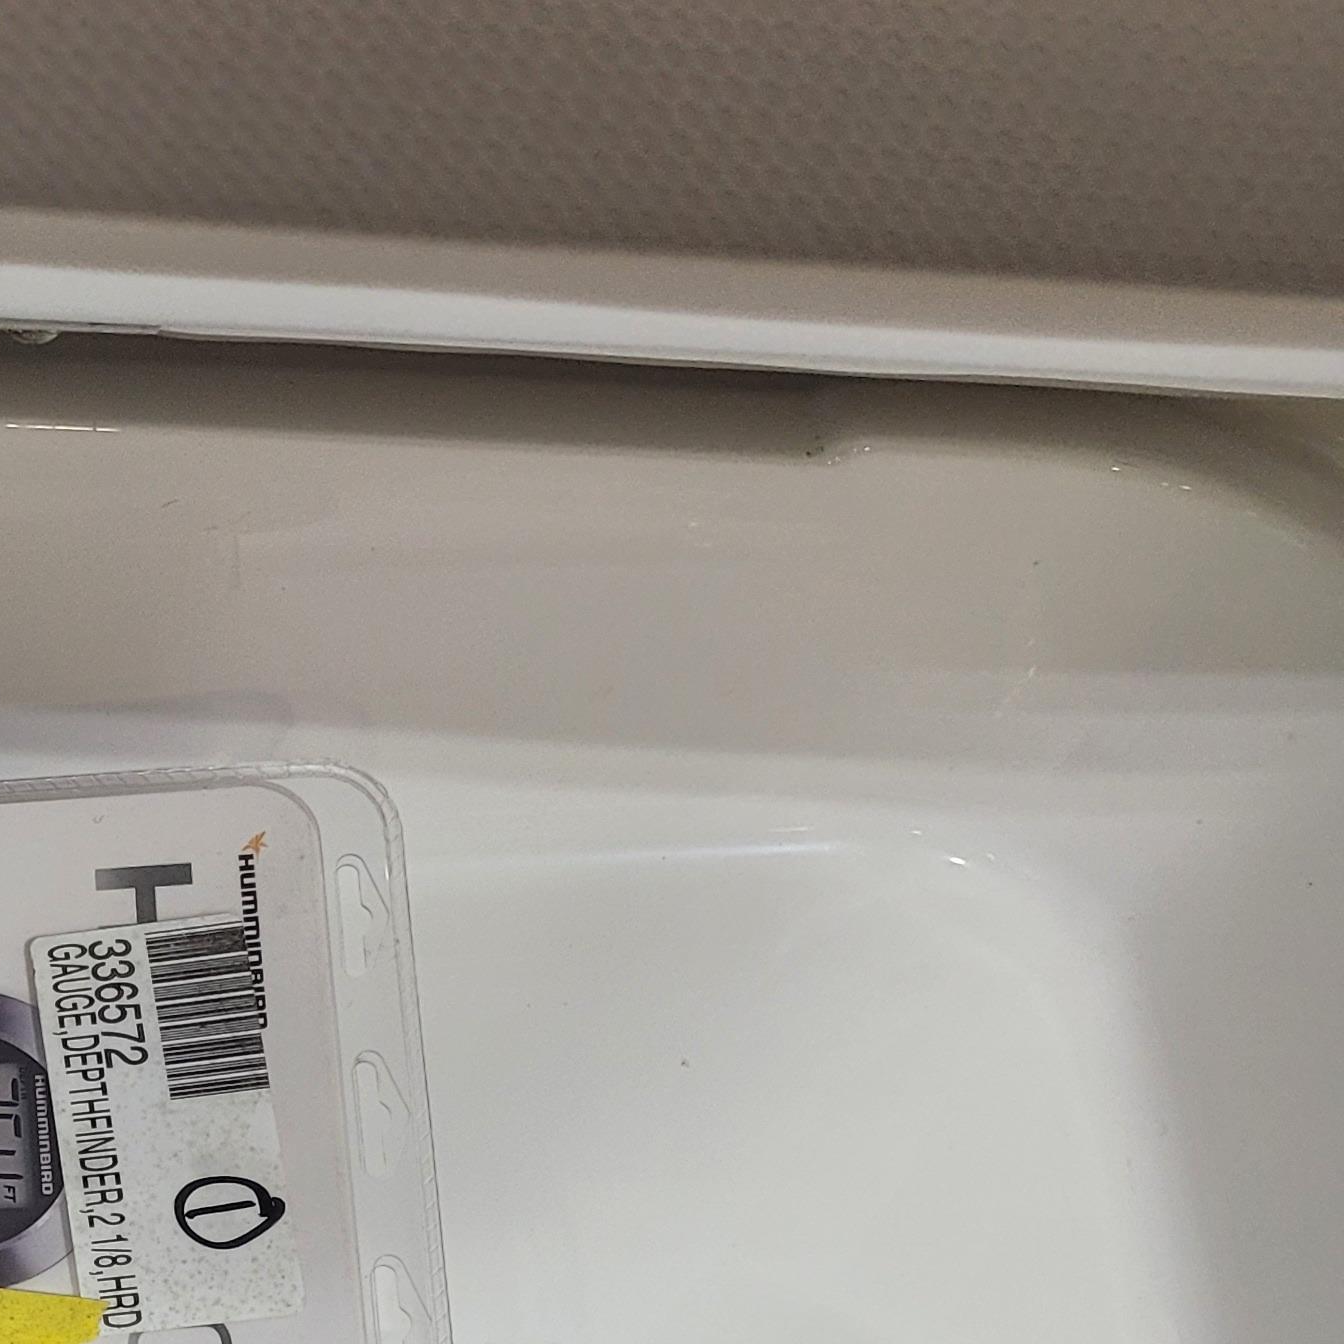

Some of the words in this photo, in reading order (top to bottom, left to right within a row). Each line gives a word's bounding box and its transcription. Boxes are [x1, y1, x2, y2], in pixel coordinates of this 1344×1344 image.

[88, 938, 150, 1069] 336572
[2, 1184, 16, 1204] FT
[34, 1075, 54, 1196] HUMMINBIRD
